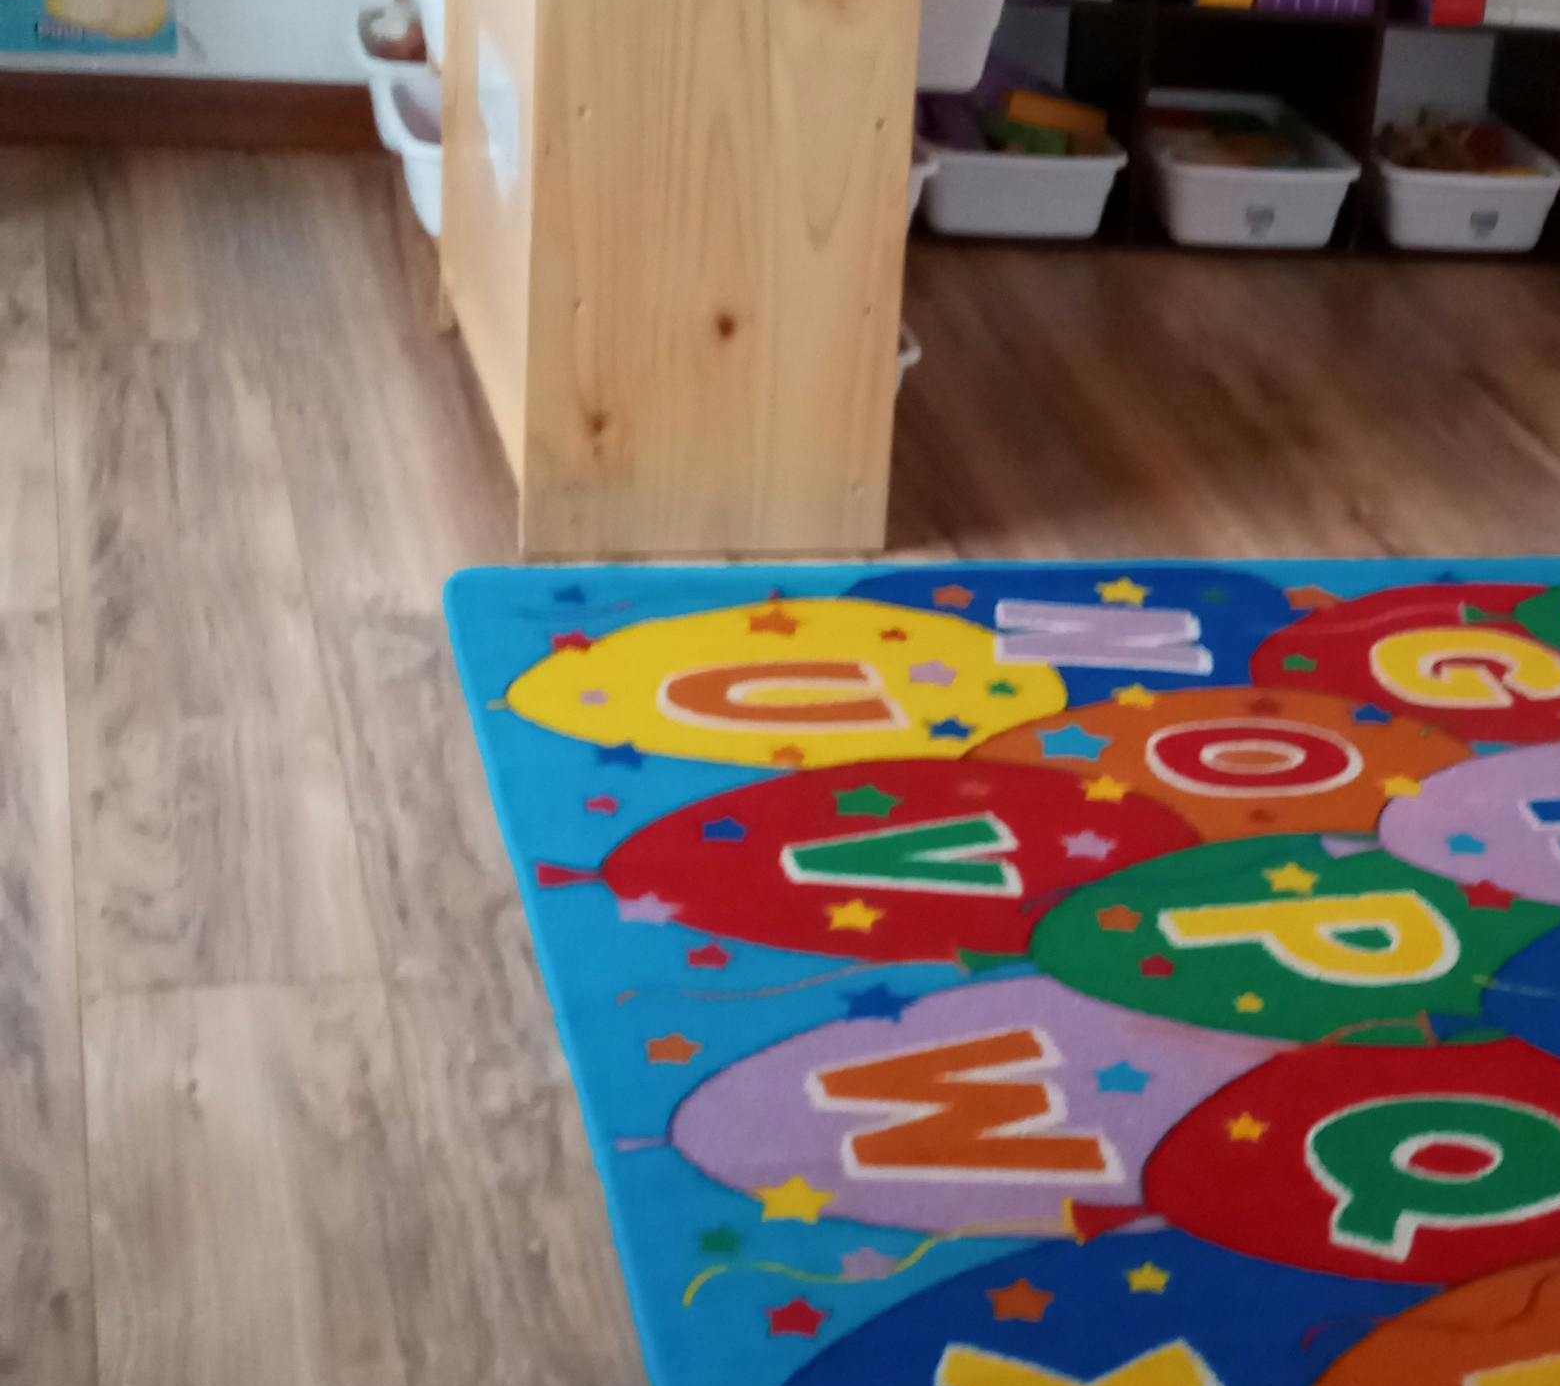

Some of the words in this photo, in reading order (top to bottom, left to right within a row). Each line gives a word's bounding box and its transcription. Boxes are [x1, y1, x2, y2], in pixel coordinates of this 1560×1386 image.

[656, 660, 912, 732] U
[1146, 718, 1363, 797] O
[780, 811, 1023, 897] V
[1158, 889, 1461, 985] P
[805, 1022, 1127, 1185] W
